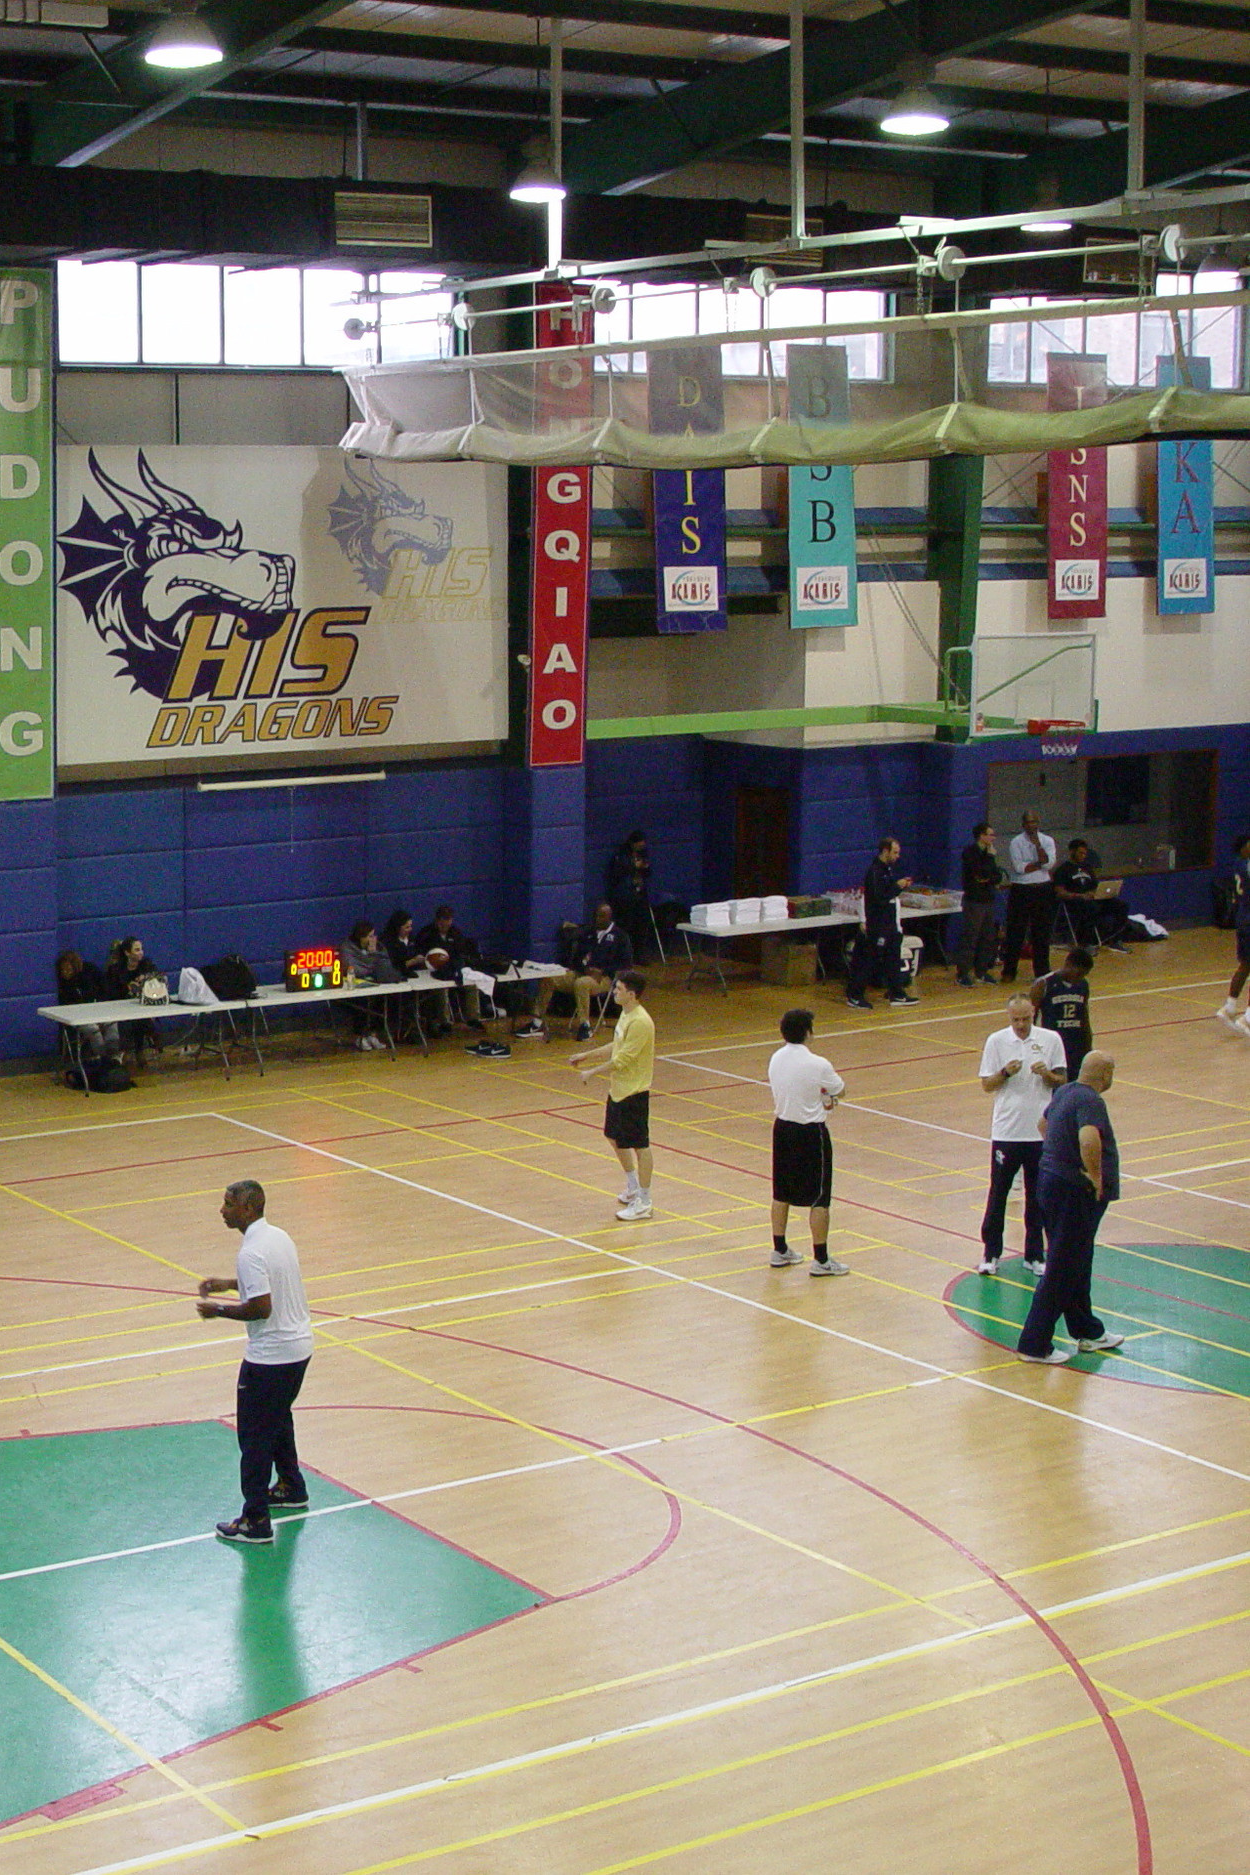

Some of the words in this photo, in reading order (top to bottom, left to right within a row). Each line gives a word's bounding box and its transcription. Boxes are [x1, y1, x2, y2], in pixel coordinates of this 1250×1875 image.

[382, 547, 493, 599] HIS
[164, 606, 371, 705] HIS
[145, 695, 399, 749] DRAGONS
[297, 949, 333, 968] 20:00
[301, 973, 310, 988] 0
[1062, 1003, 1076, 1019] 12
